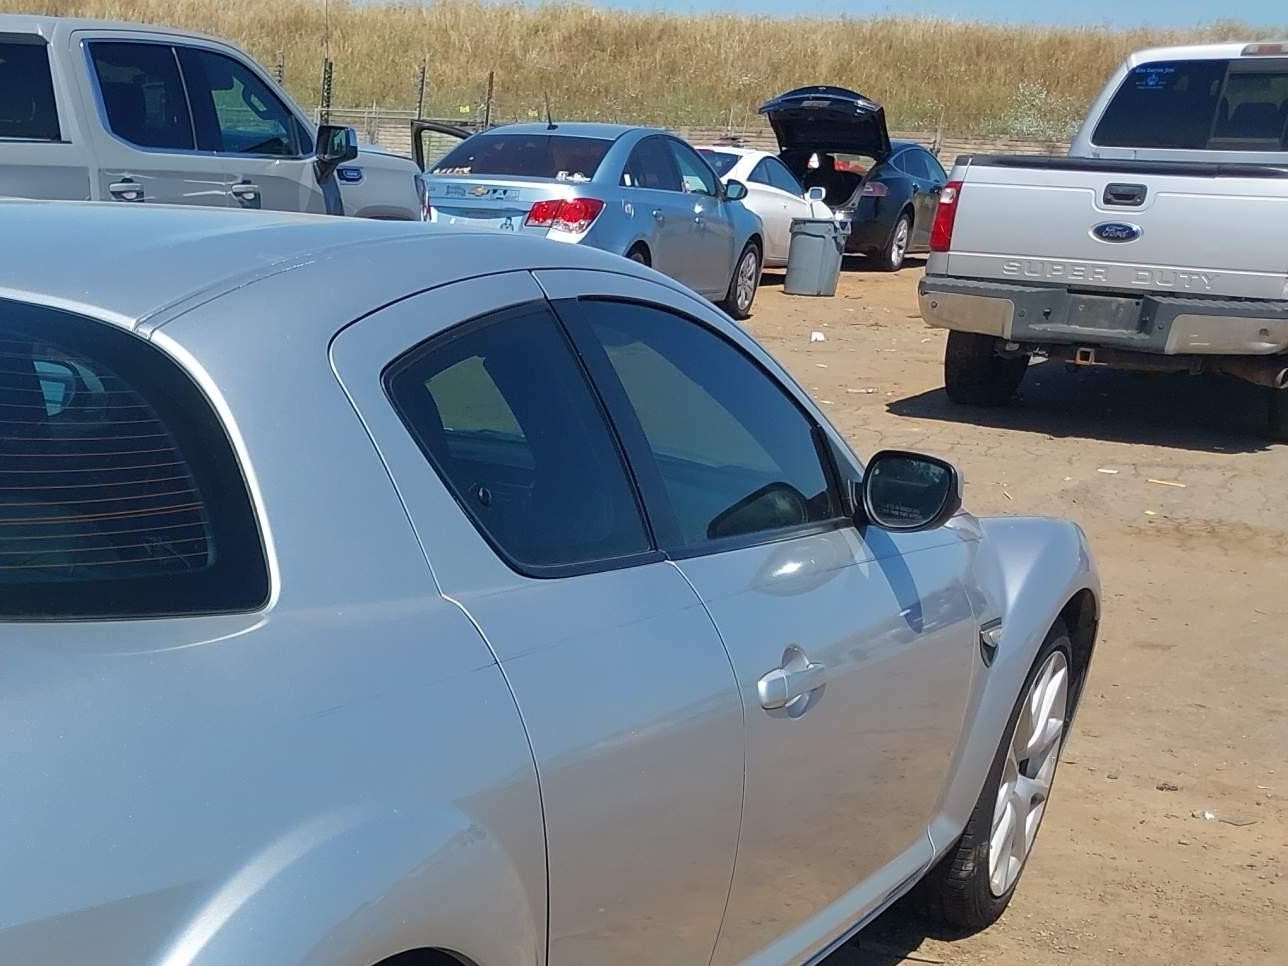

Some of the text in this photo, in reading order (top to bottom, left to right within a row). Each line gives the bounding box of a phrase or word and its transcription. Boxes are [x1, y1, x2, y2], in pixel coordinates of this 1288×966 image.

[1102, 224, 1130, 239] Ford
[1001, 259, 1217, 290] SUPER DUTY
